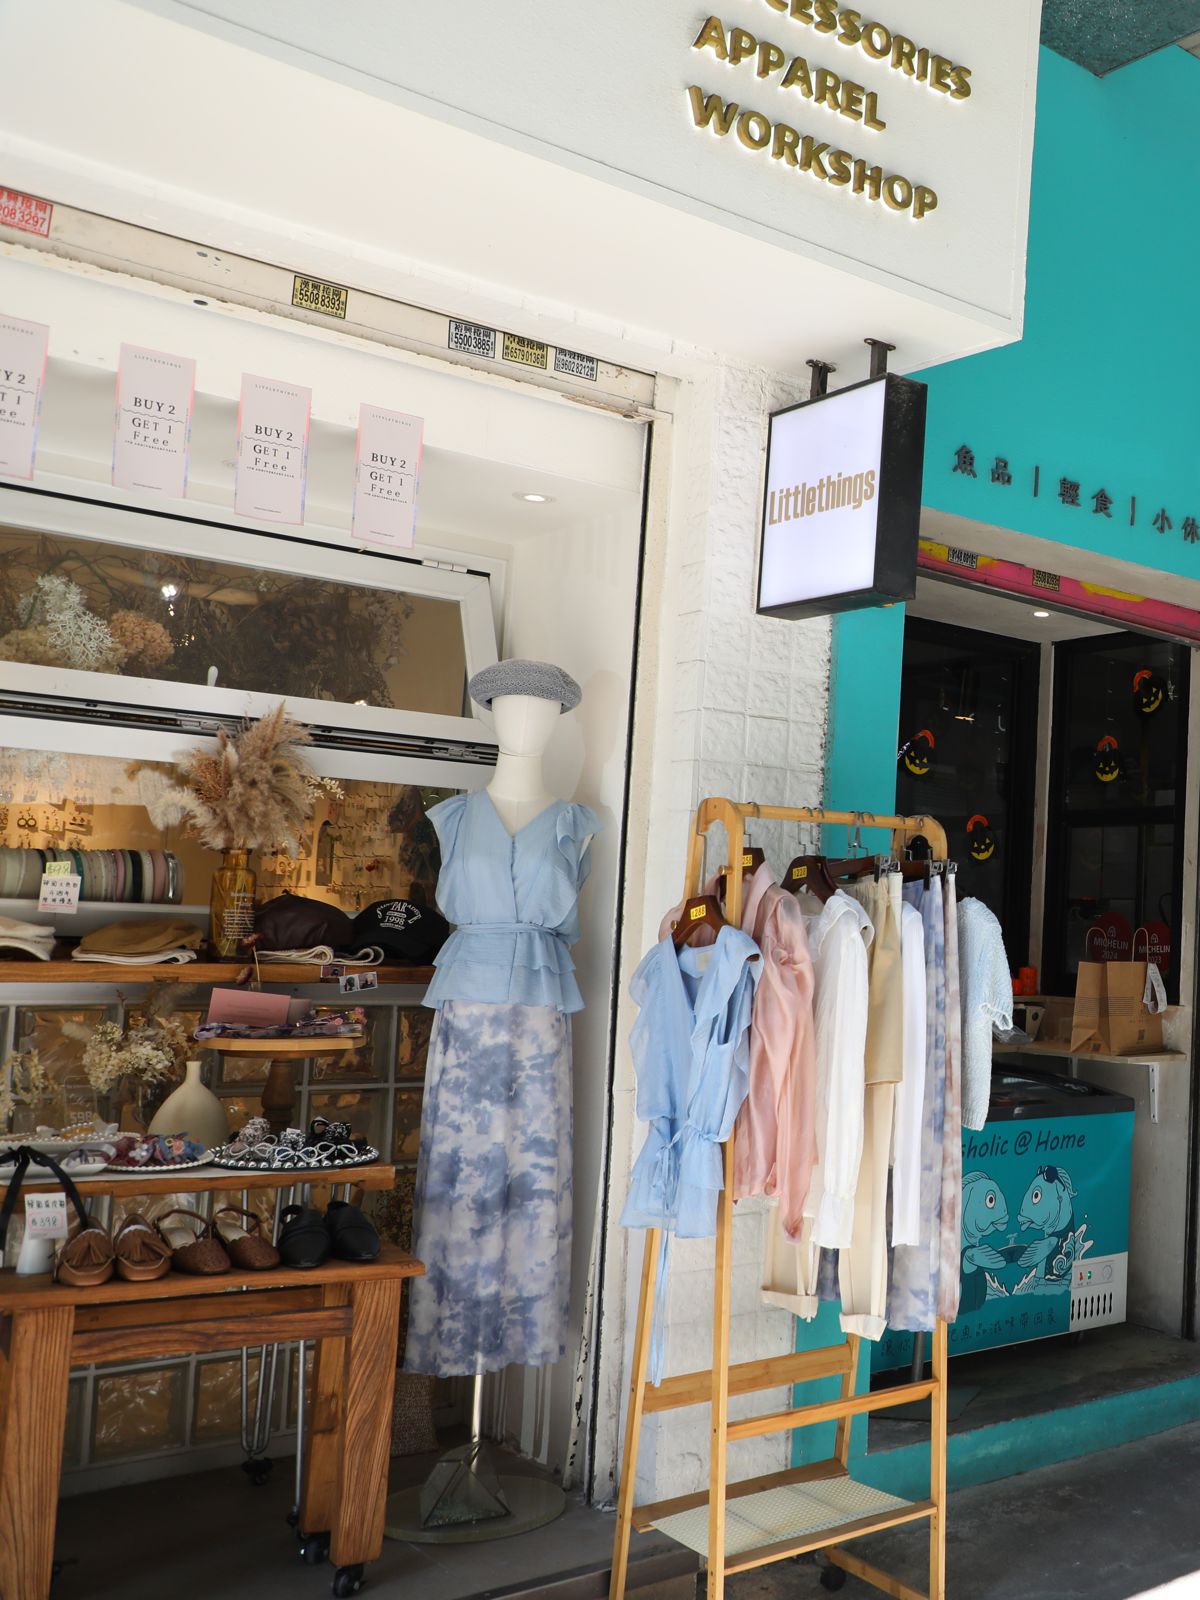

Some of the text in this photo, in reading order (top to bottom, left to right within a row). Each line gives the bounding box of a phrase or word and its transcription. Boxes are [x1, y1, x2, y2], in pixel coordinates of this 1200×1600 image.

[692, 16, 886, 131] APPAREL
[686, 85, 938, 219] WORKSHOP
[299, 289, 341, 311] 5508 8393
[454, 333, 491, 352] 5500 3885
[509, 346, 541, 365] 6579 0136
[561, 357, 590, 377] 9602 8212
[134, 396, 176, 415] BUY 2
[131, 417, 160, 431] GET
[254, 424, 293, 442] BUY 2
[133, 431, 169, 447] Free
[253, 444, 278, 457] GET
[254, 457, 287, 472] Free
[371, 452, 406, 468] BUY 2
[369, 471, 392, 483] GET
[951, 443, 1013, 486] 魚品
[1057, 476, 1114, 519] 輕食
[371, 483, 401, 498] Free
[768, 468, 876, 526] Littlethings
[384, 915, 405, 926] 1998
[1093, 937, 1129, 950] MICHELIN
[1138, 945, 1171, 954] MICHELIN
[961, 1130, 1087, 1160] sholic @ Home
